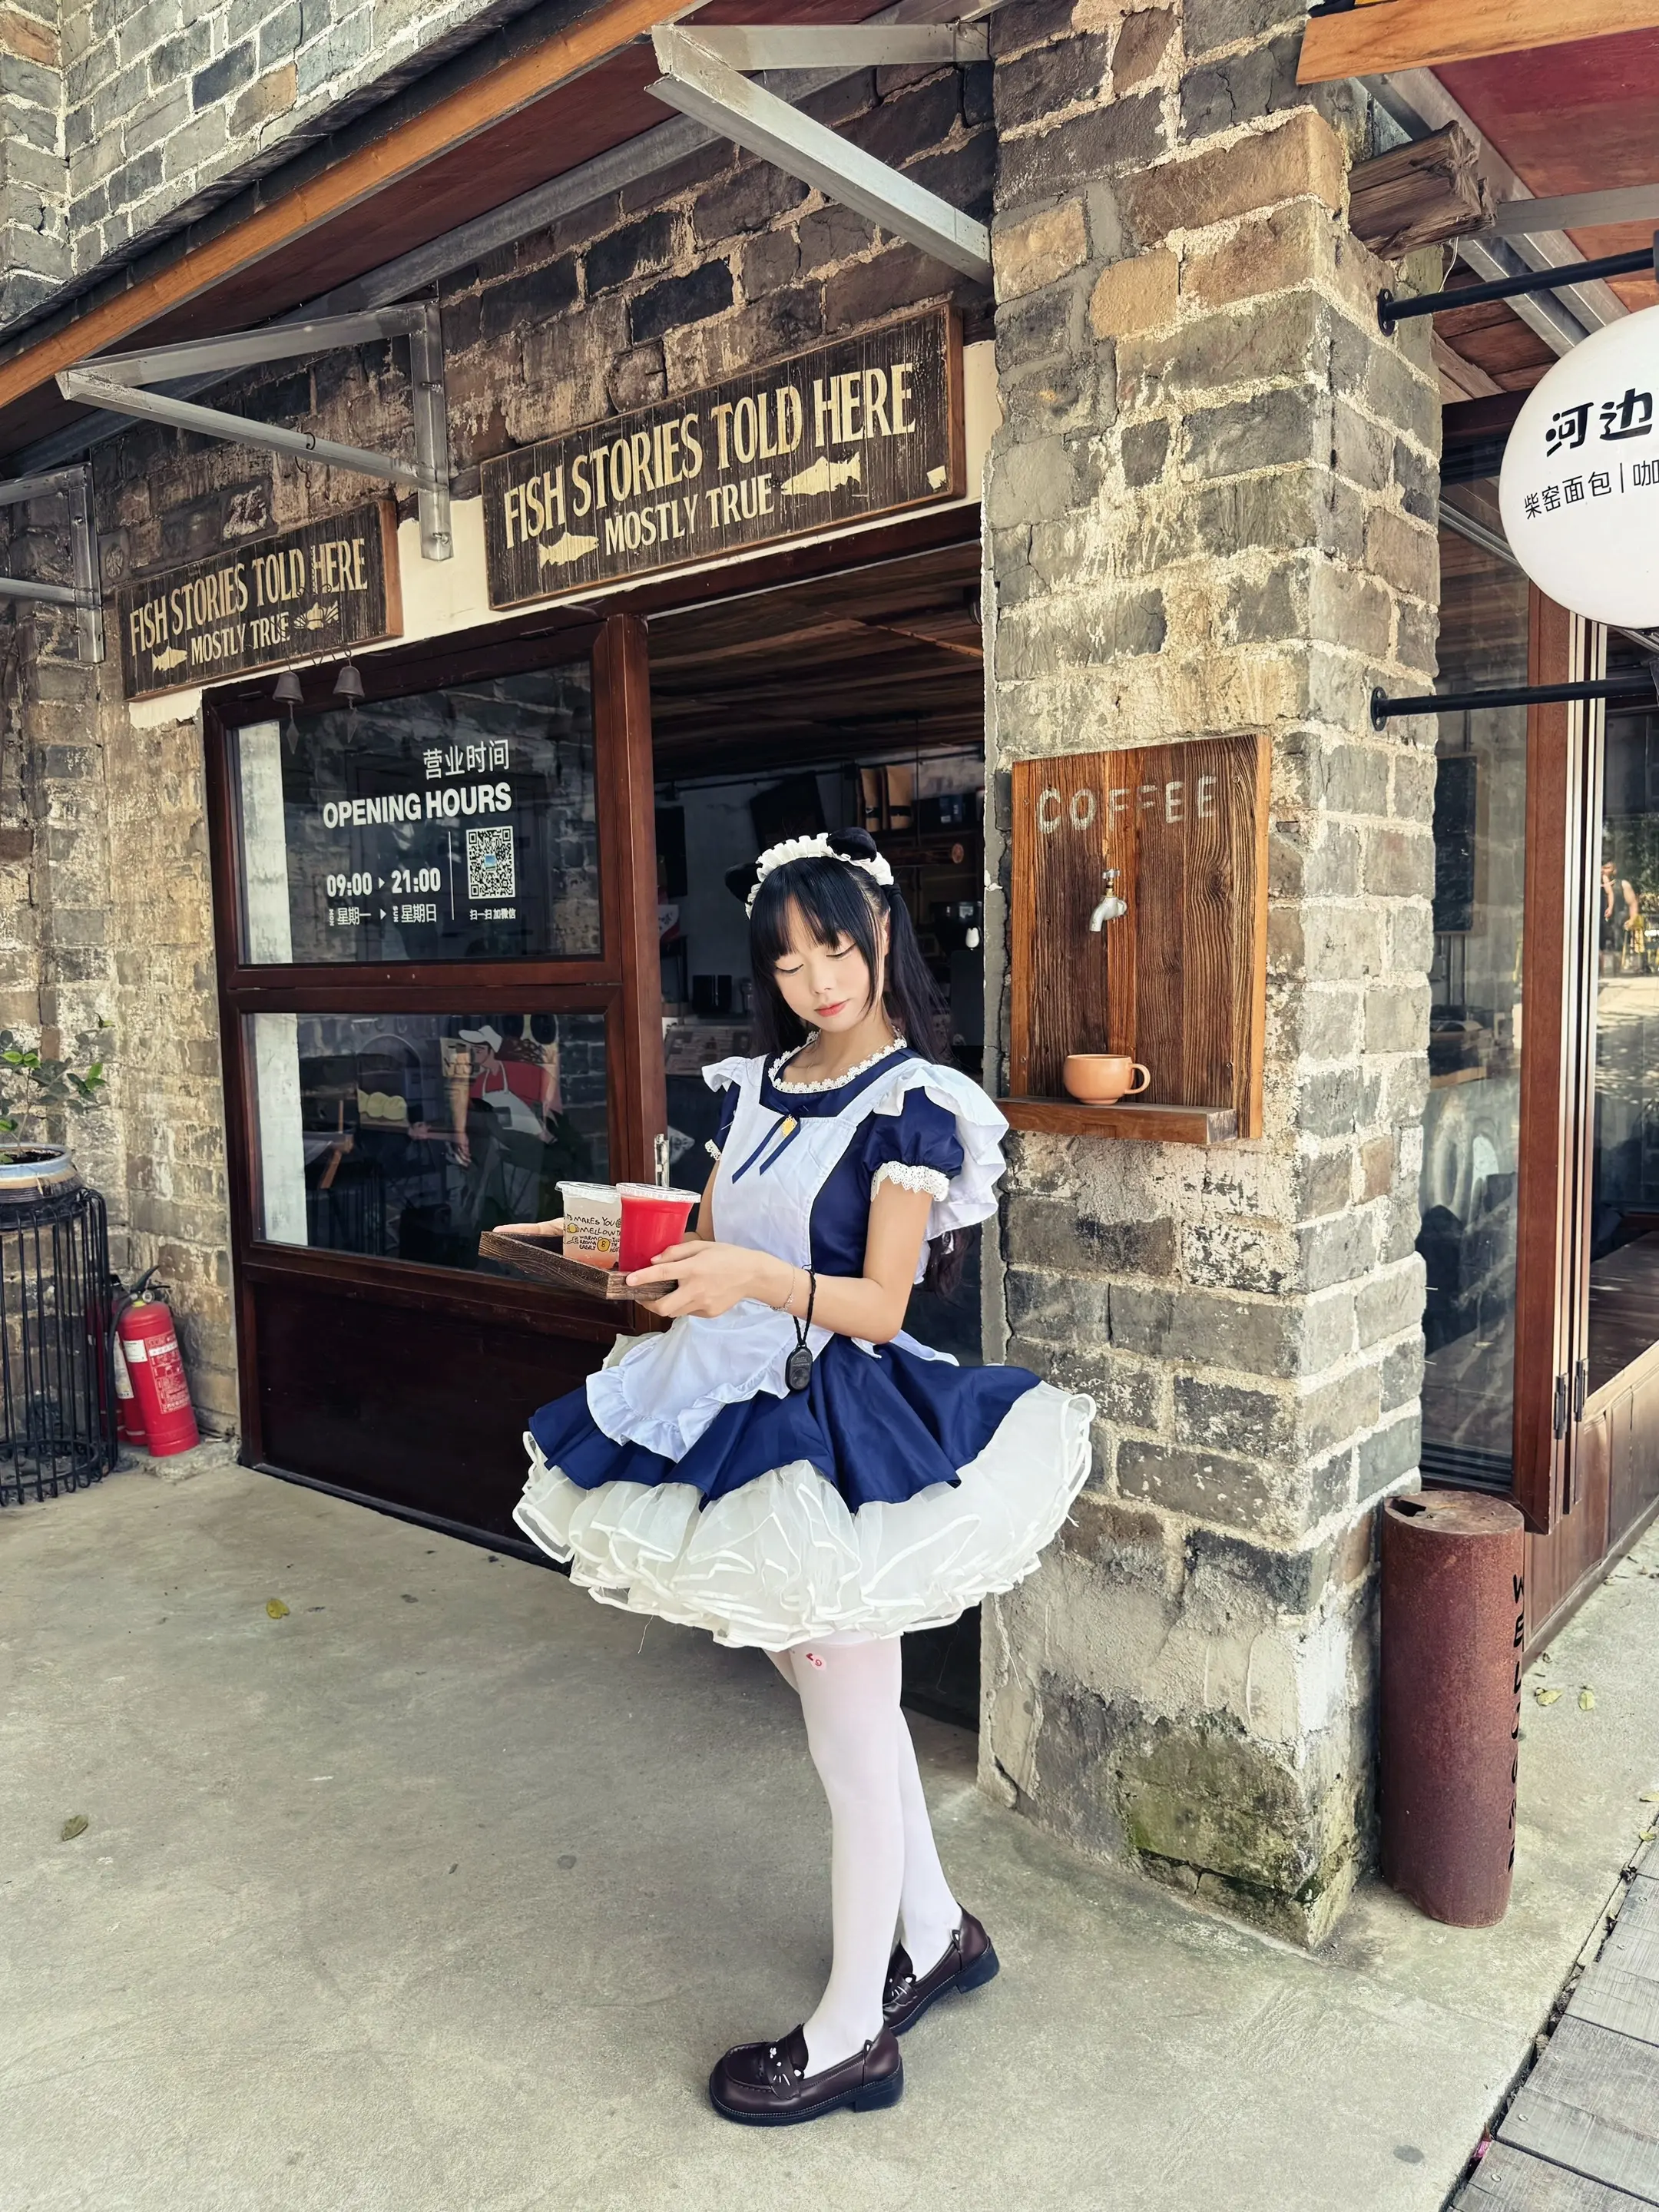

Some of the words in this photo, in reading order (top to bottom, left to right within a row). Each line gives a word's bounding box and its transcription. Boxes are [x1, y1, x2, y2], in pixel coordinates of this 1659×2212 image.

[1545, 388, 1653, 457] 河边
[504, 465, 565, 549] FISH
[571, 412, 703, 517] STORIES
[710, 385, 803, 471] TOLD
[813, 363, 916, 448] HERE
[604, 494, 699, 555] MOSTLY
[705, 472, 775, 528] TRUE
[1524, 471, 1612, 520] 柴窑面包
[130, 595, 168, 656] FISH
[171, 563, 249, 636] STORIES
[251, 548, 306, 607] TOLD
[310, 538, 368, 594] HERE
[190, 623, 246, 666] MOSTLY
[250, 611, 290, 651] TRUE
[422, 739, 510, 780] 营业时间
[323, 793, 422, 829] OPENING
[426, 782, 512, 819] HOURS
[1038, 774, 1217, 834] COFFEE
[326, 872, 373, 898] 09:00
[391, 867, 441, 894] 21:00
[337, 906, 372, 926] 星期一
[401, 903, 436, 924] 星期日
[574, 1216, 600, 1225] MAKES
[601, 1217, 614, 1227] YOU
[579, 1227, 615, 1237] MELLOW
